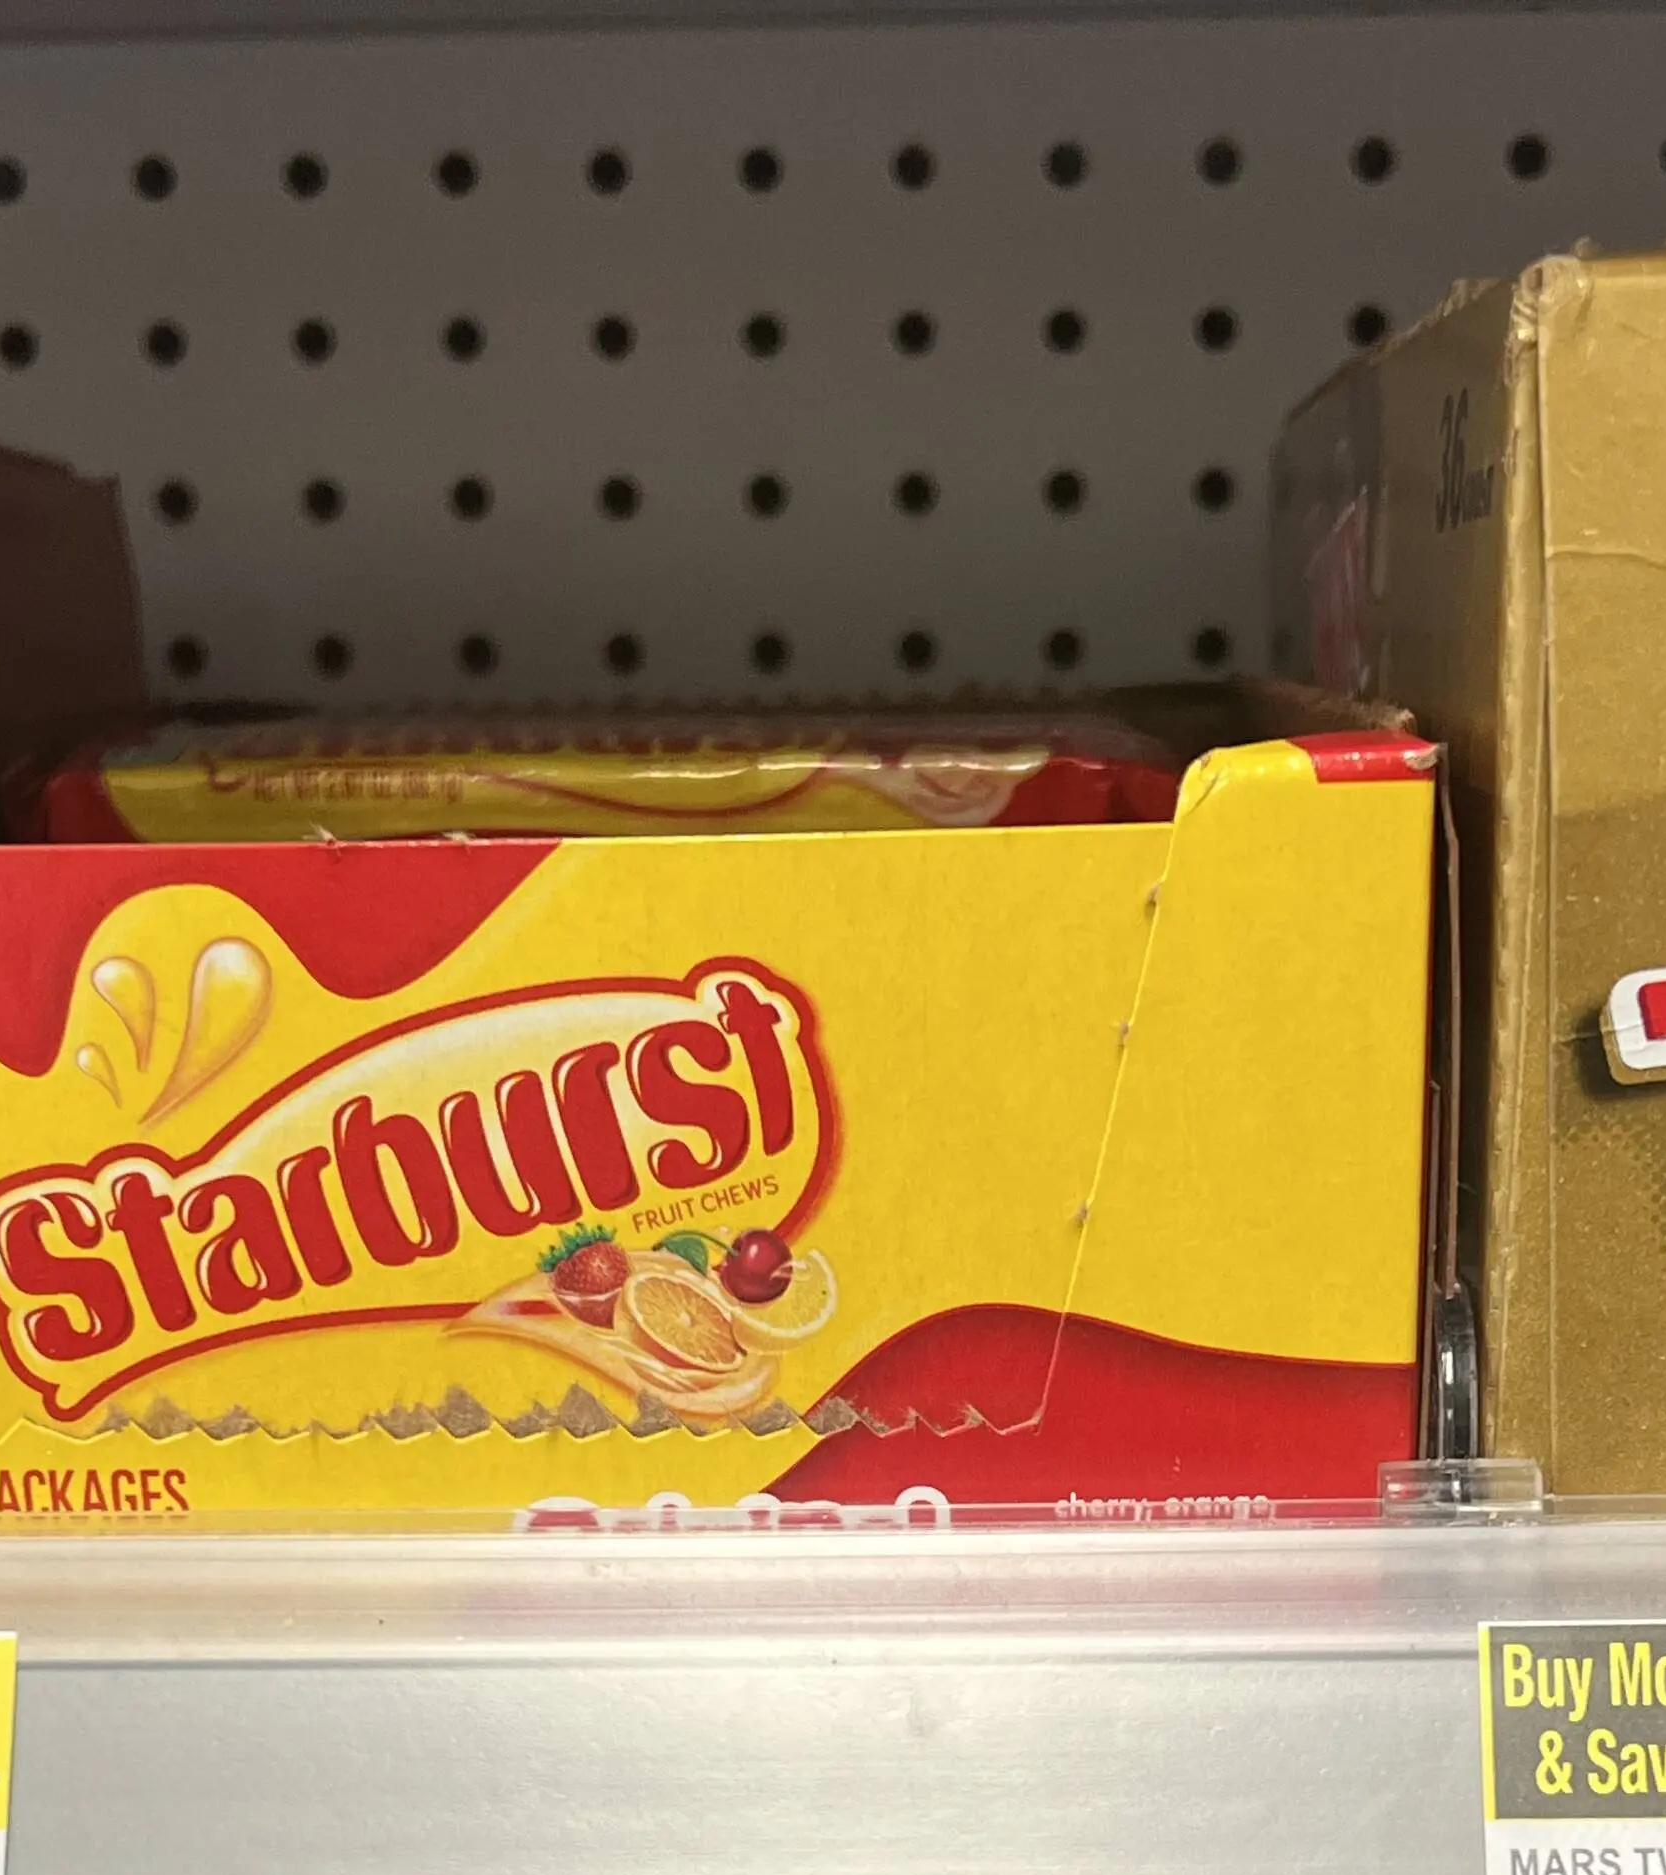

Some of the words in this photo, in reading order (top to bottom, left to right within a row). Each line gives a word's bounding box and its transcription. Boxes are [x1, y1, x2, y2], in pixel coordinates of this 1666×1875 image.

[631, 1194, 696, 1236] FRUIT
[698, 1172, 780, 1212] CHEWS
[1502, 1643, 1594, 1721] Buy
[1535, 1730, 1573, 1796] &
